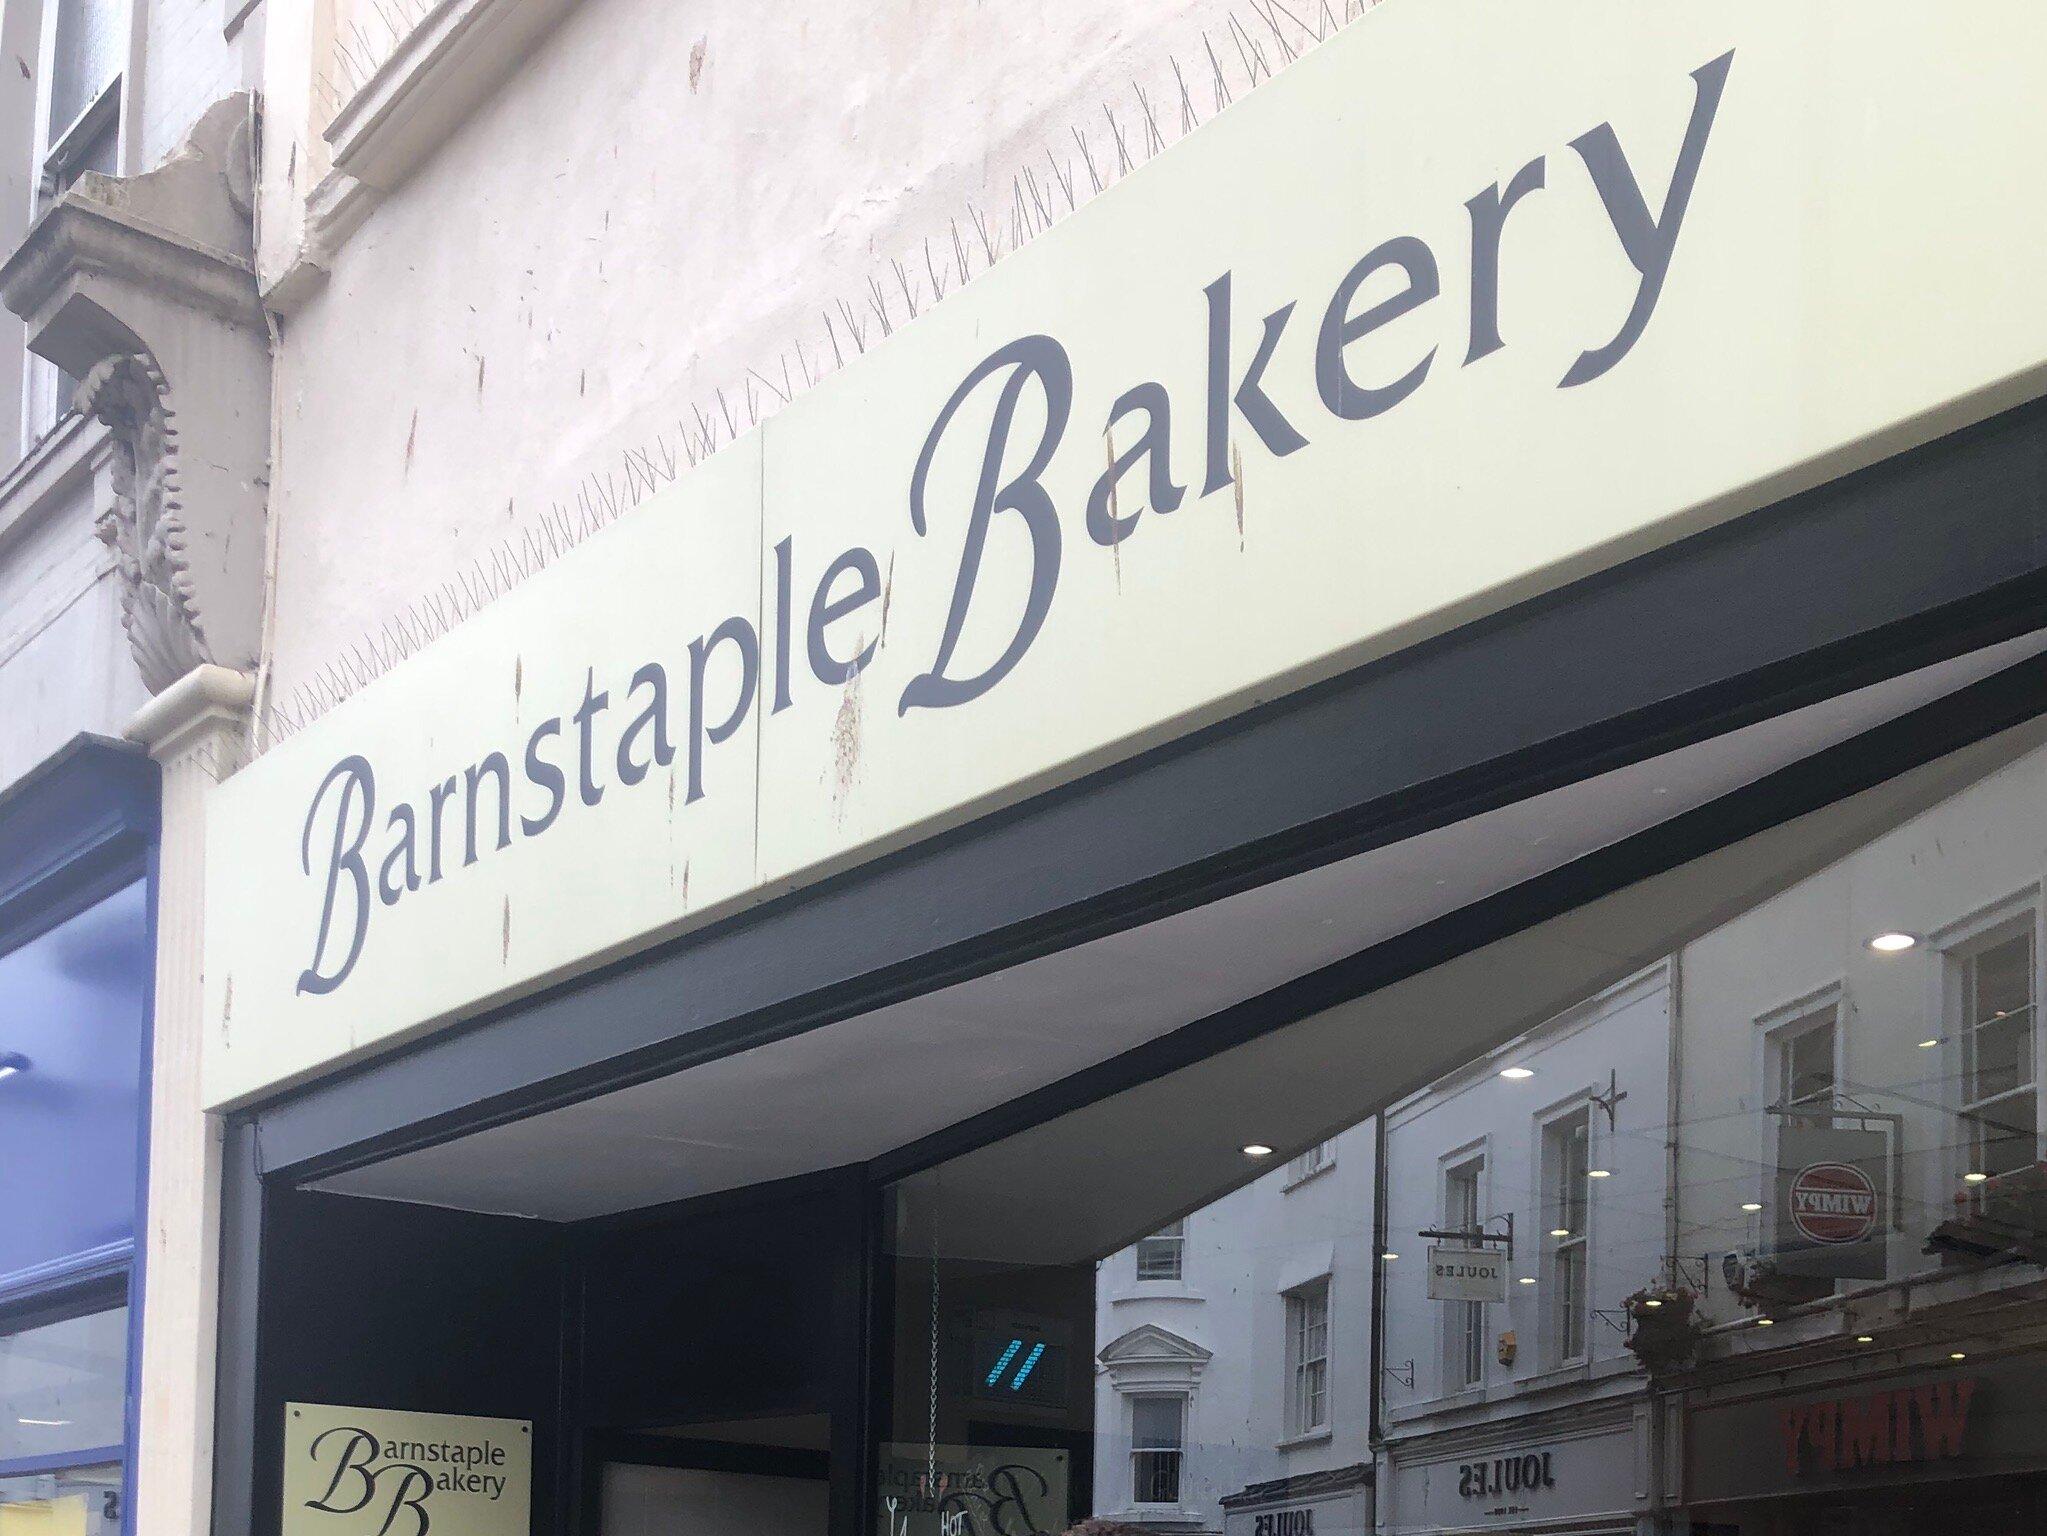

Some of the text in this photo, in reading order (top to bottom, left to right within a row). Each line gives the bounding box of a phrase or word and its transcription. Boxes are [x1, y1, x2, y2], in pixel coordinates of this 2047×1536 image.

[296, 47, 1737, 997] Barnstaple Bakery
[304, 1426, 506, 1514] Barnstaple
[372, 1463, 506, 1536] Bakery
